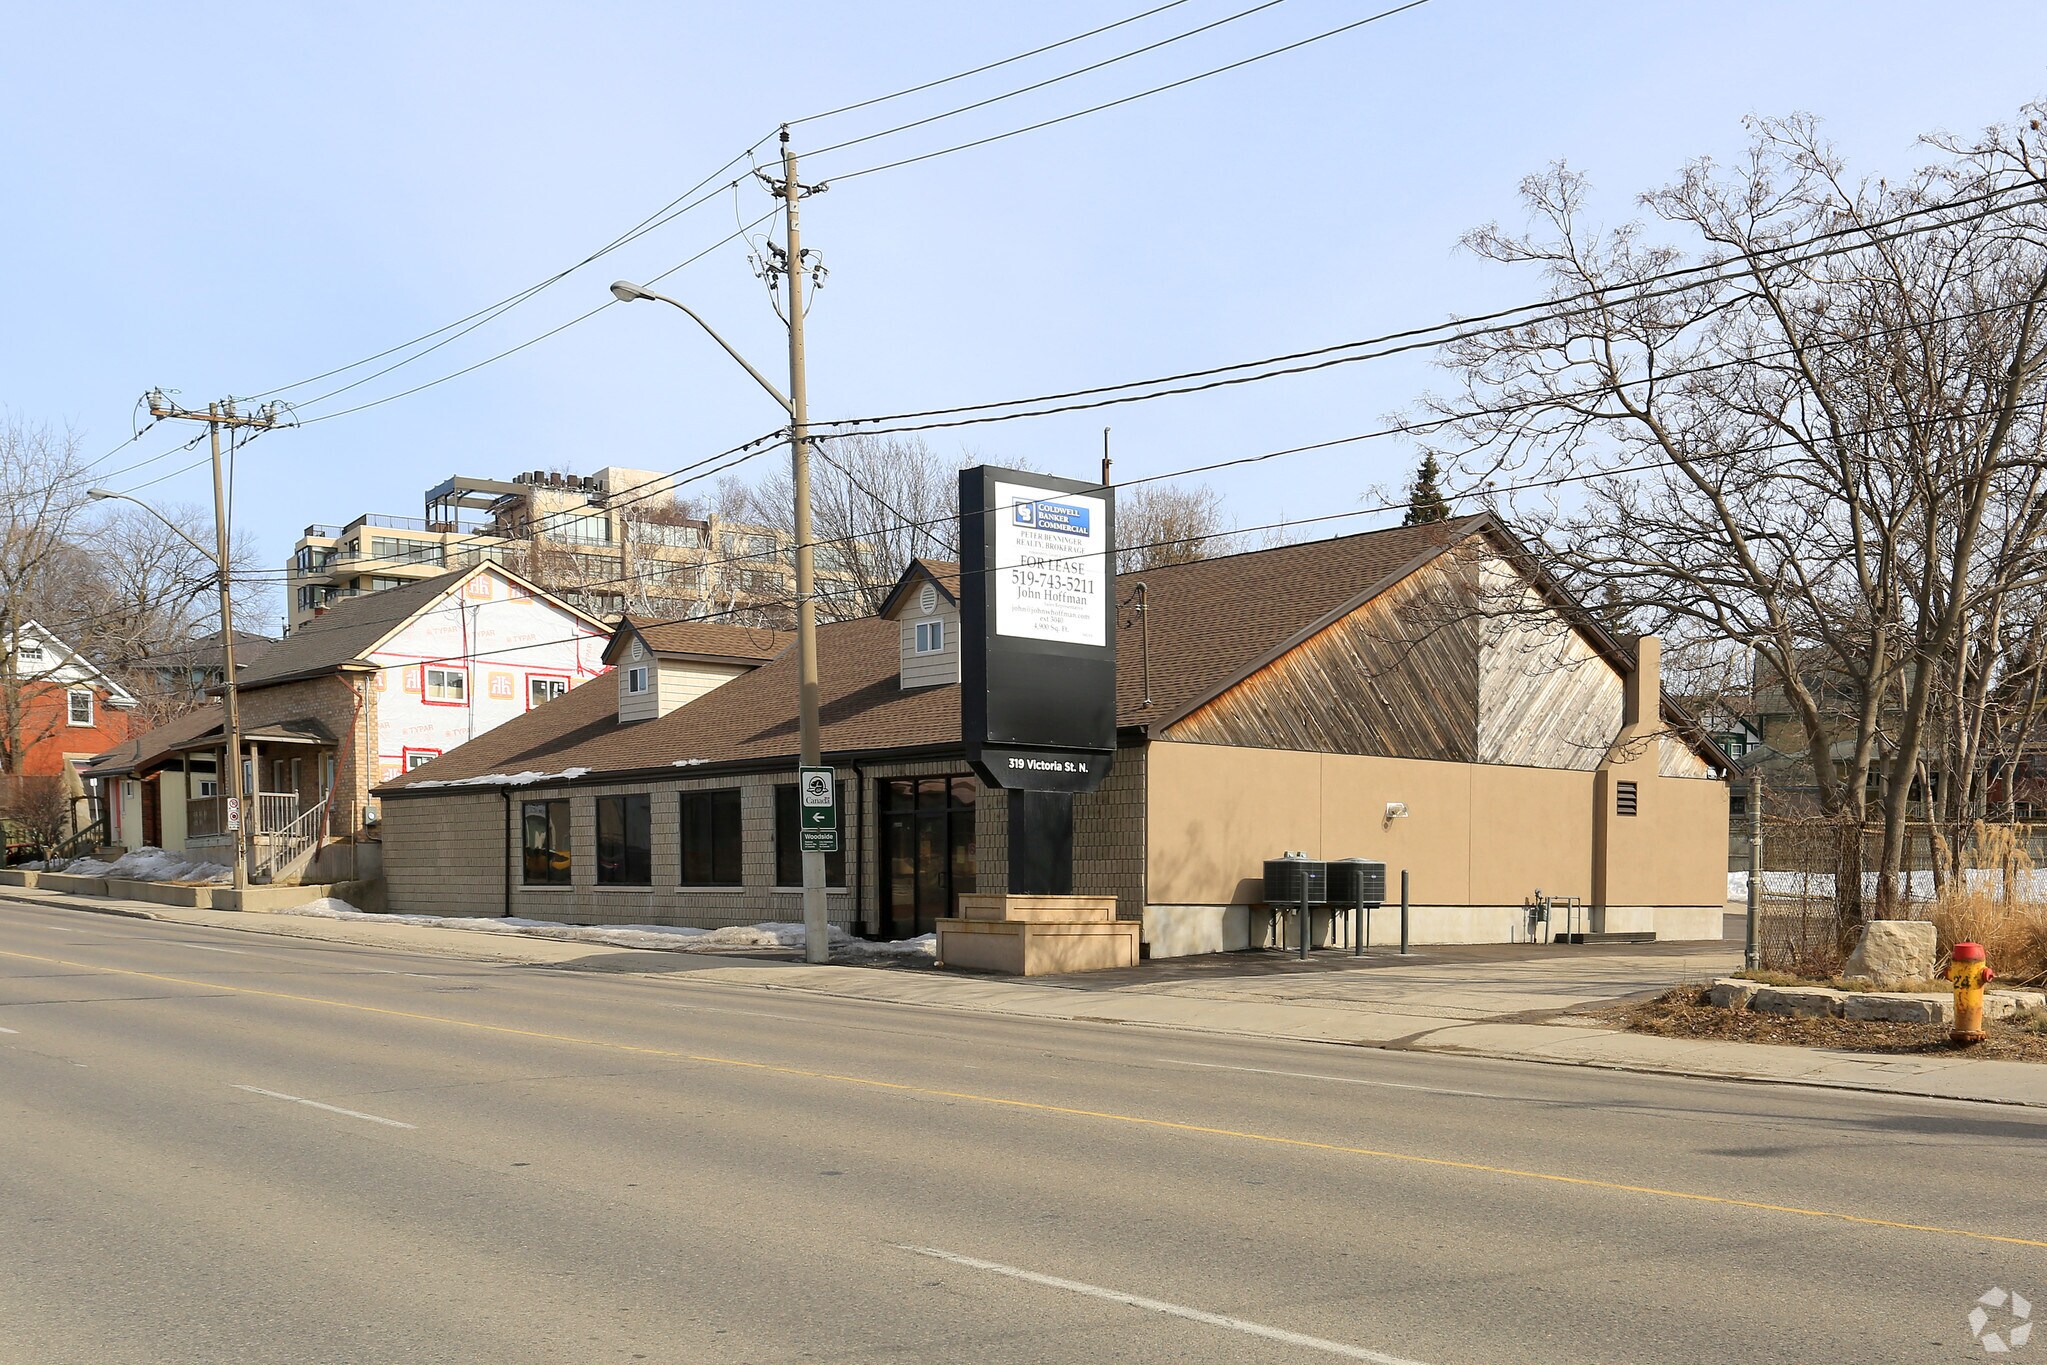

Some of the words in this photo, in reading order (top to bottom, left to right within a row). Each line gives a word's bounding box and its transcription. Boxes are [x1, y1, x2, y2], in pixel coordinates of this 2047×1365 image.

[1038, 504, 1080, 517] COLDWELL
[1038, 512, 1069, 524] BANKER
[1038, 520, 1088, 534] COMMERCIAL
[1021, 530, 1043, 540] PETER
[1044, 534, 1082, 545] BENNINGER
[1046, 543, 1086, 554] BROKERAGE
[1021, 555, 1044, 569] FOR
[1048, 559, 1085, 575] LEASE
[1012, 569, 1094, 594] 519-743-5211
[1017, 586, 1041, 599] John
[1044, 590, 1087, 605] Hoffman
[432, 626, 458, 634] TYPAR
[513, 634, 536, 642] TYPAR
[409, 724, 434, 734] TYPAR
[1008, 757, 1024, 769] 319
[1026, 758, 1063, 772] Victoria
[1064, 762, 1077, 772] St.
[1079, 762, 1089, 773] N.
[1953, 976, 1971, 989] 24
